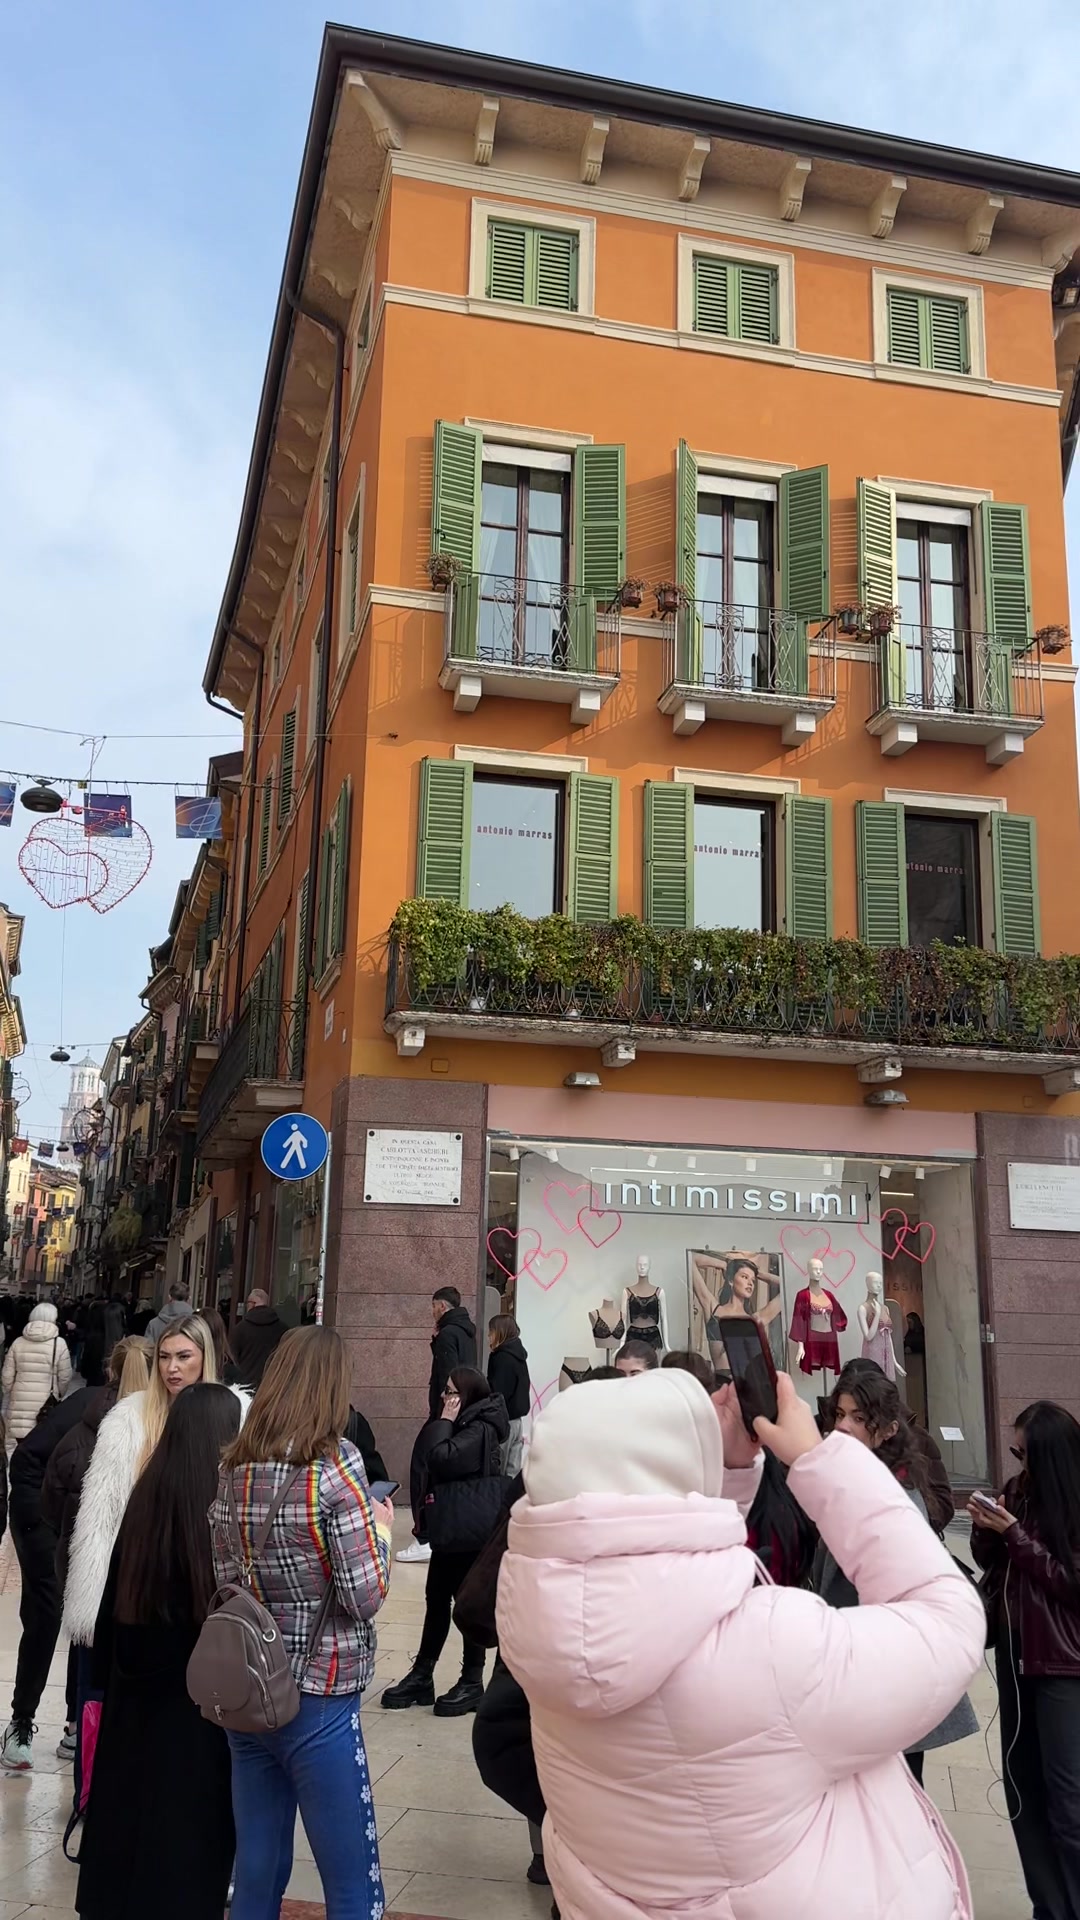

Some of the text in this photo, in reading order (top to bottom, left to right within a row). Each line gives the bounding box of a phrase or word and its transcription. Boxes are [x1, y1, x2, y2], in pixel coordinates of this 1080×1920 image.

[477, 825, 552, 839] antonio marras
[732, 848, 759, 858] marra
[937, 865, 964, 875] marra
[603, 1179, 857, 1216] intimissimi
